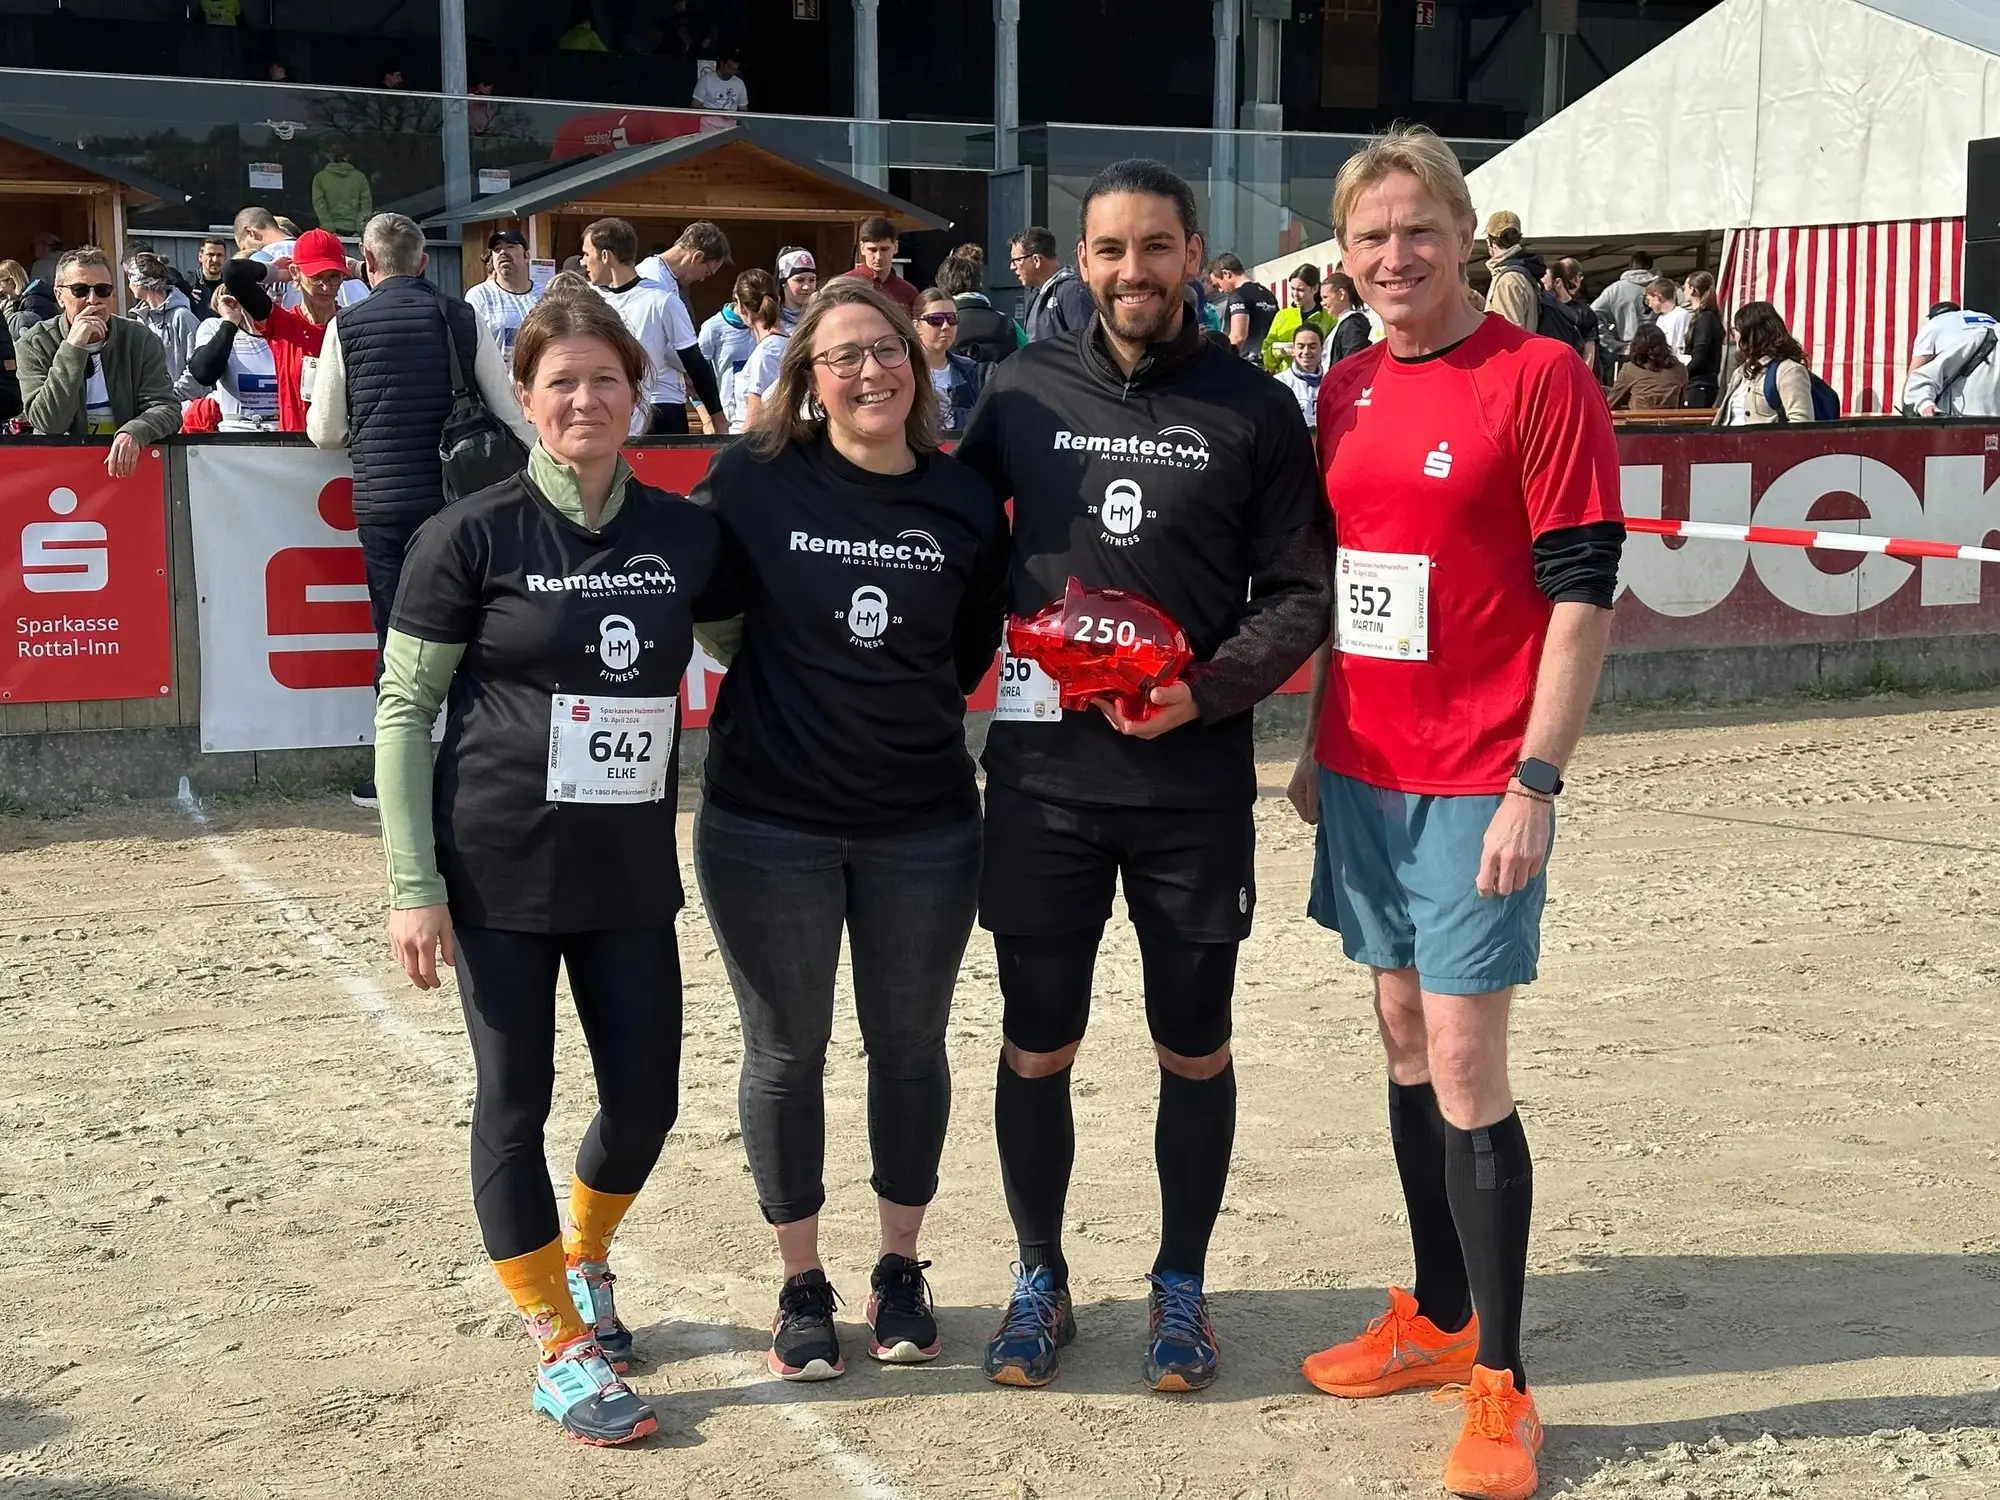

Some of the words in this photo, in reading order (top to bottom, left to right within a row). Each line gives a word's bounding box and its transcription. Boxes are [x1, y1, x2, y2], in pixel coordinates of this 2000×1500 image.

[1053, 431, 1173, 457] Rematec
[1101, 452, 1190, 468] Maschinenbau
[1087, 505, 1098, 514] 20
[1146, 509, 1157, 519] 20
[1100, 531, 1140, 546] FITNESS
[1613, 453, 2000, 617] uer
[789, 531, 912, 561] Rematec
[841, 556, 929, 571] Maschinenbau
[525, 571, 644, 592] Rematec
[581, 587, 663, 599] Maschinenbau
[1350, 583, 1391, 618] 552
[834, 611, 845, 619] 20
[892, 616, 903, 624] 20
[16, 614, 119, 637] Sparkasse
[1352, 619, 1384, 633] MARTIN
[1073, 615, 1153, 653] 250,-
[18, 638, 120, 658] Rottal-Inn
[584, 645, 596, 653] 20
[643, 640, 655, 649] 20
[849, 635, 885, 649] FITNESS
[599, 667, 640, 683] FITNESS
[611, 716, 625, 724] April
[588, 730, 652, 762] 642
[607, 767, 637, 779] ELKE
[581, 788, 593, 796] TuS
